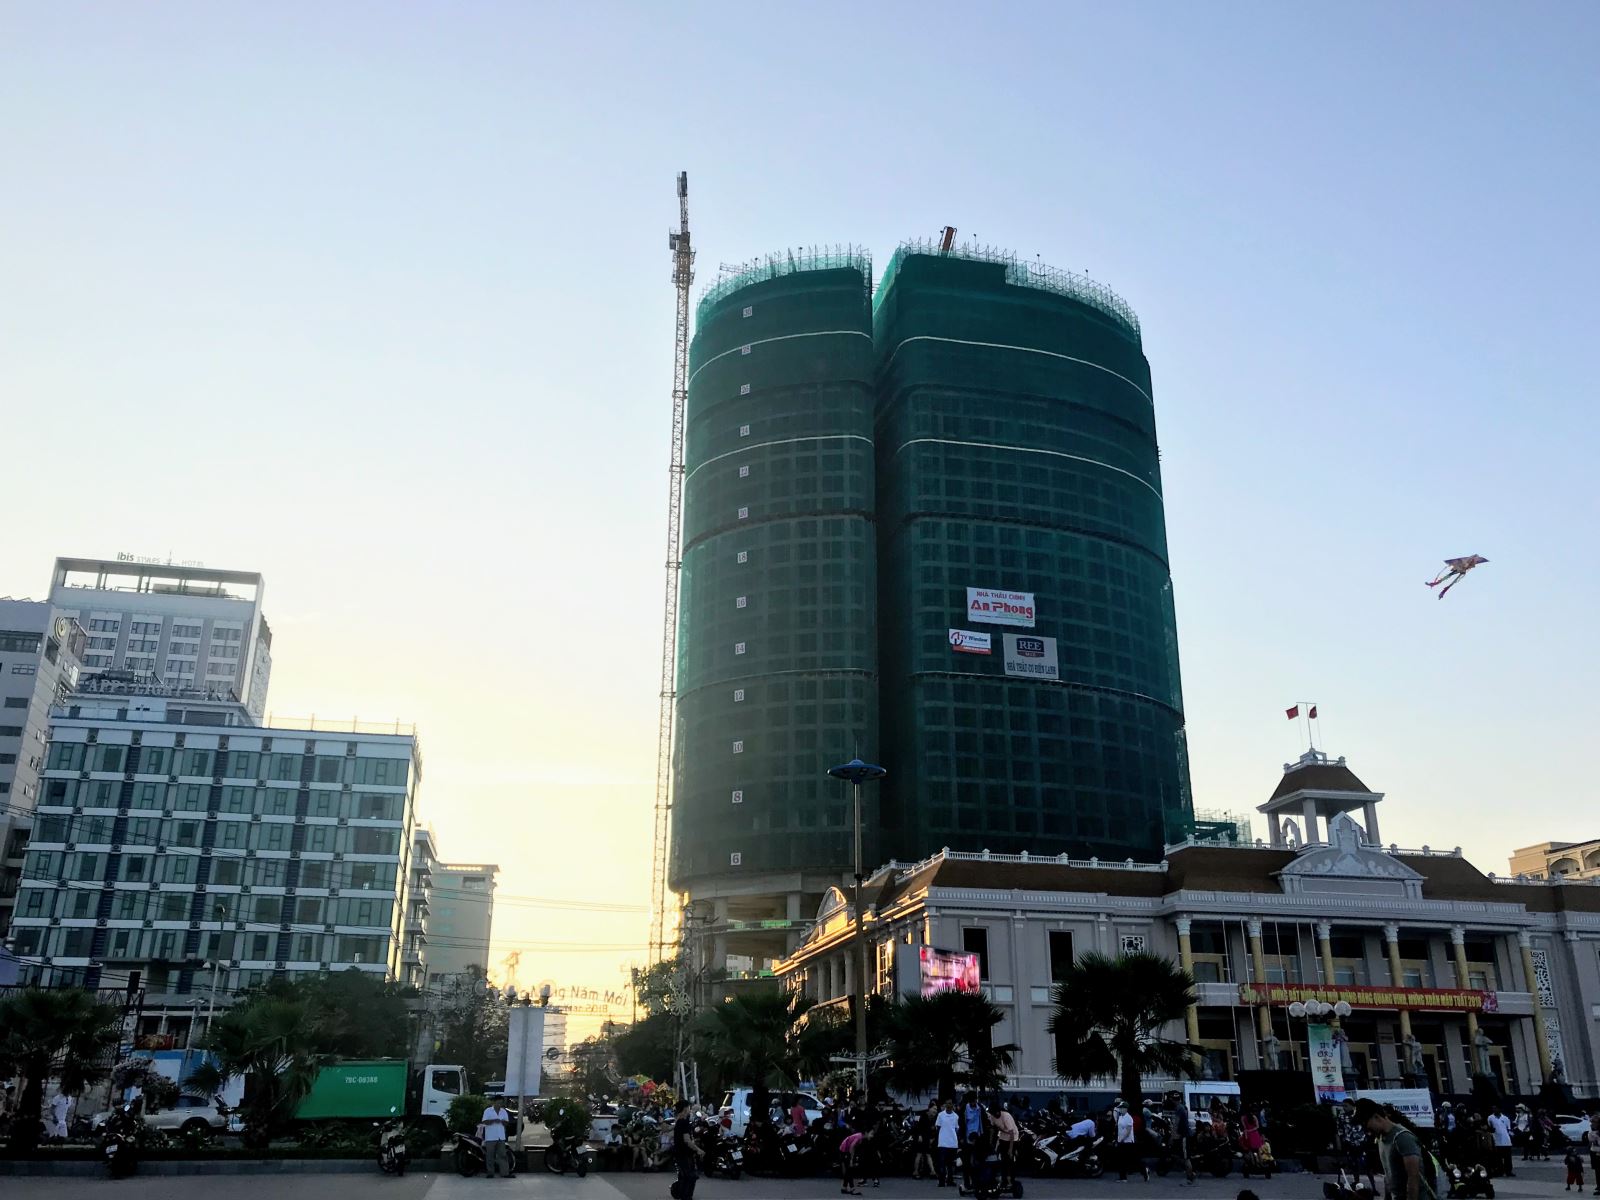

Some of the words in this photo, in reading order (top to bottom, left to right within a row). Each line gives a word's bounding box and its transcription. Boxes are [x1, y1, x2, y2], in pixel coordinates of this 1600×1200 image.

[971, 600, 990, 611] An
[991, 602, 1034, 619] Phong
[1019, 640, 1042, 650] REE
[571, 985, 598, 999] Năm
